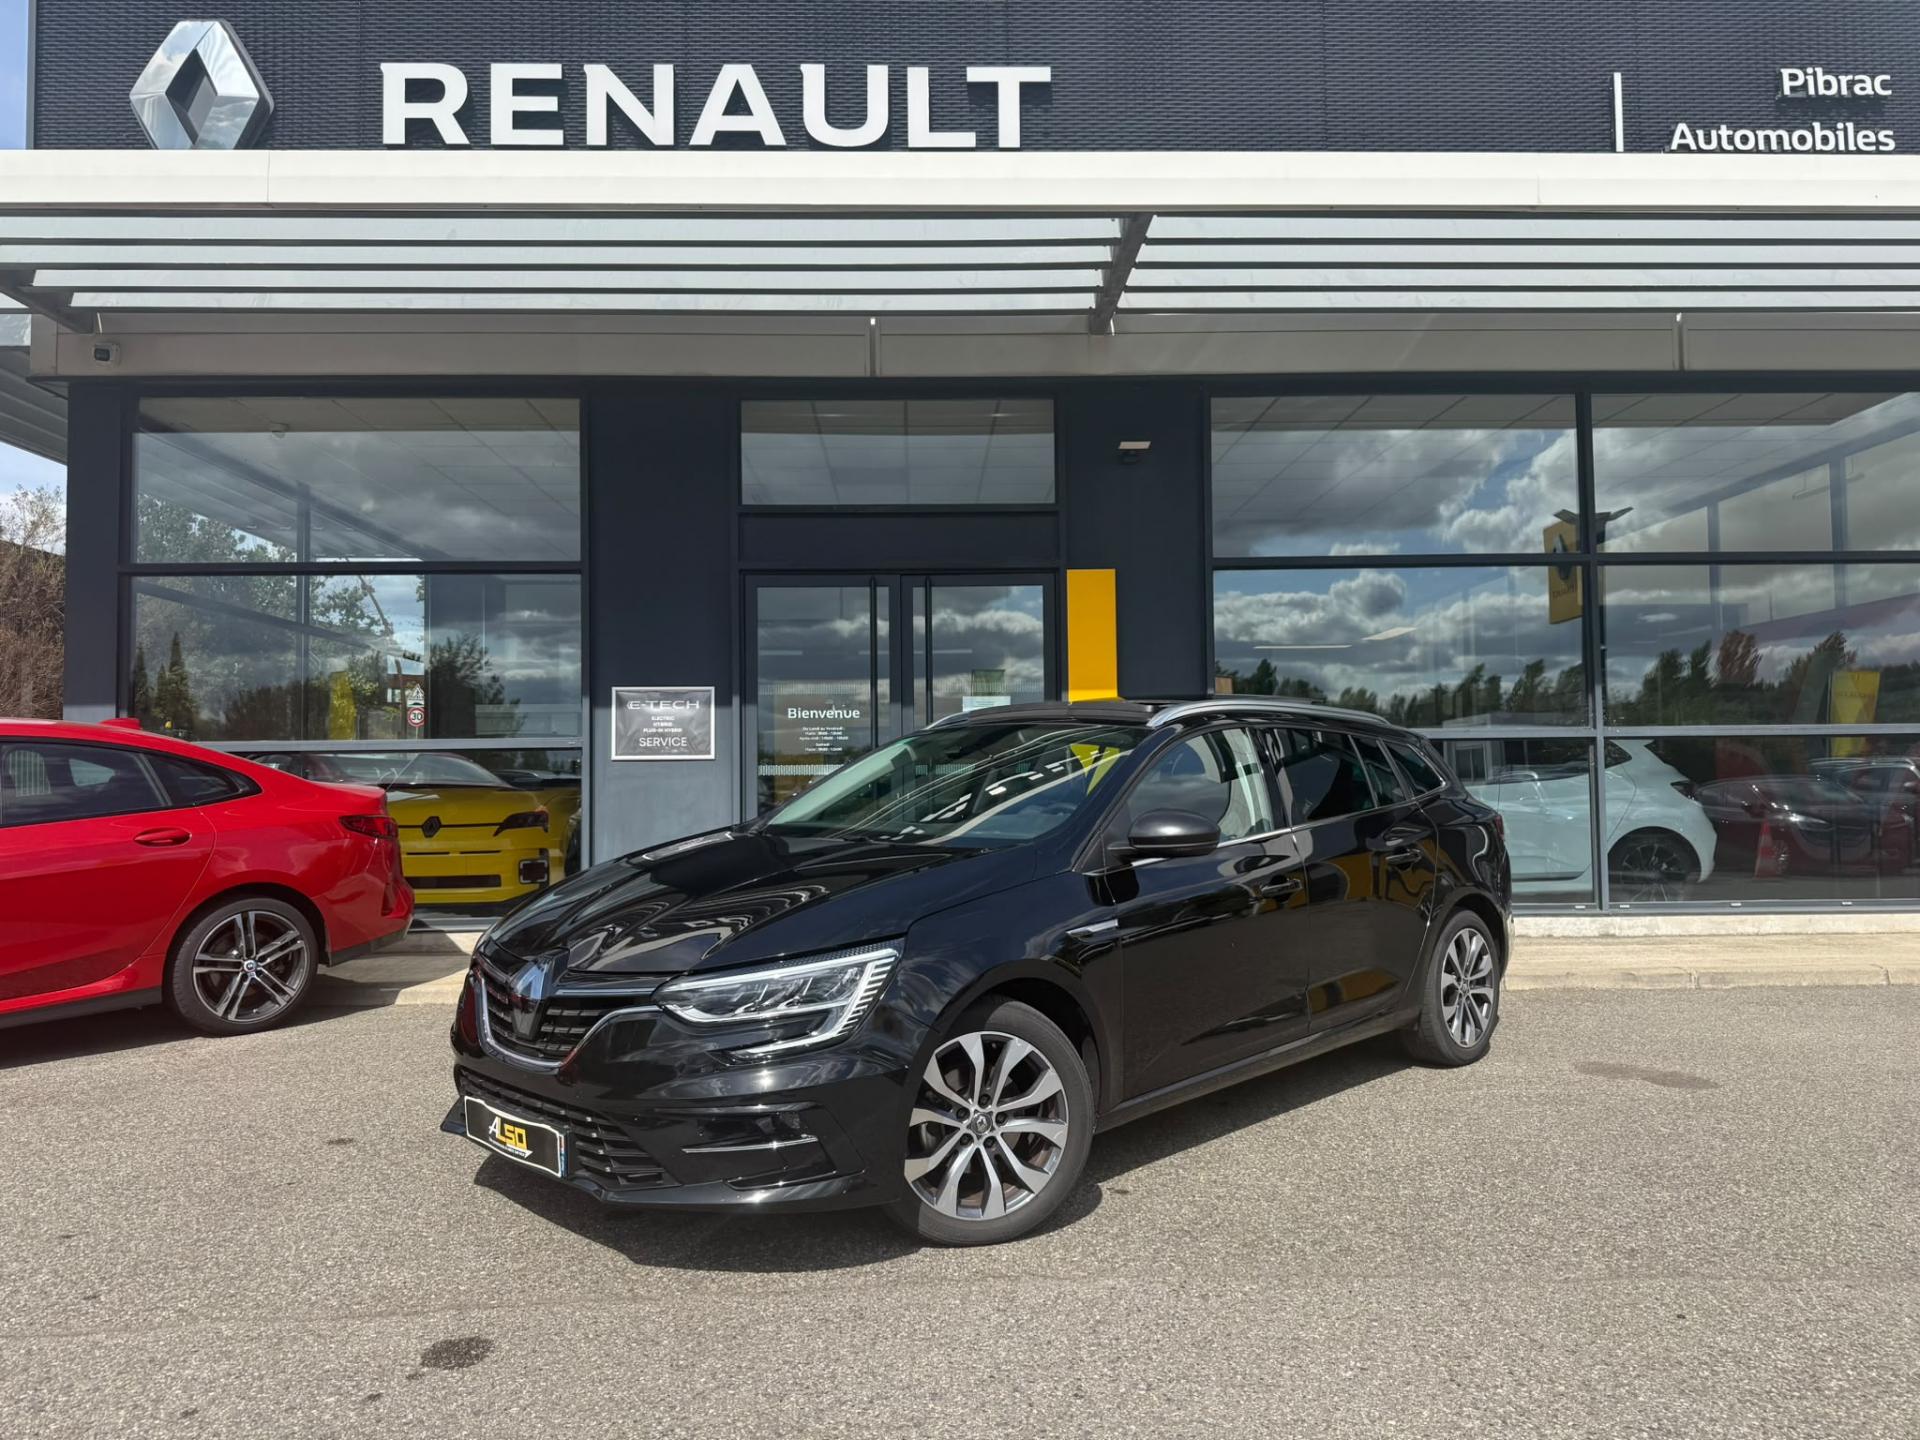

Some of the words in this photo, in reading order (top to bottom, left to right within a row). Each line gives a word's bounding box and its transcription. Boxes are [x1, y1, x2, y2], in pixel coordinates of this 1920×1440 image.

[1780, 67, 1893, 96] Pibrac
[379, 63, 1051, 148] RENAULT
[1670, 122, 1896, 152] Automobiles
[627, 700, 700, 710] E-TECH
[787, 707, 861, 719] Bienvenue
[639, 737, 688, 747] SERVICE
